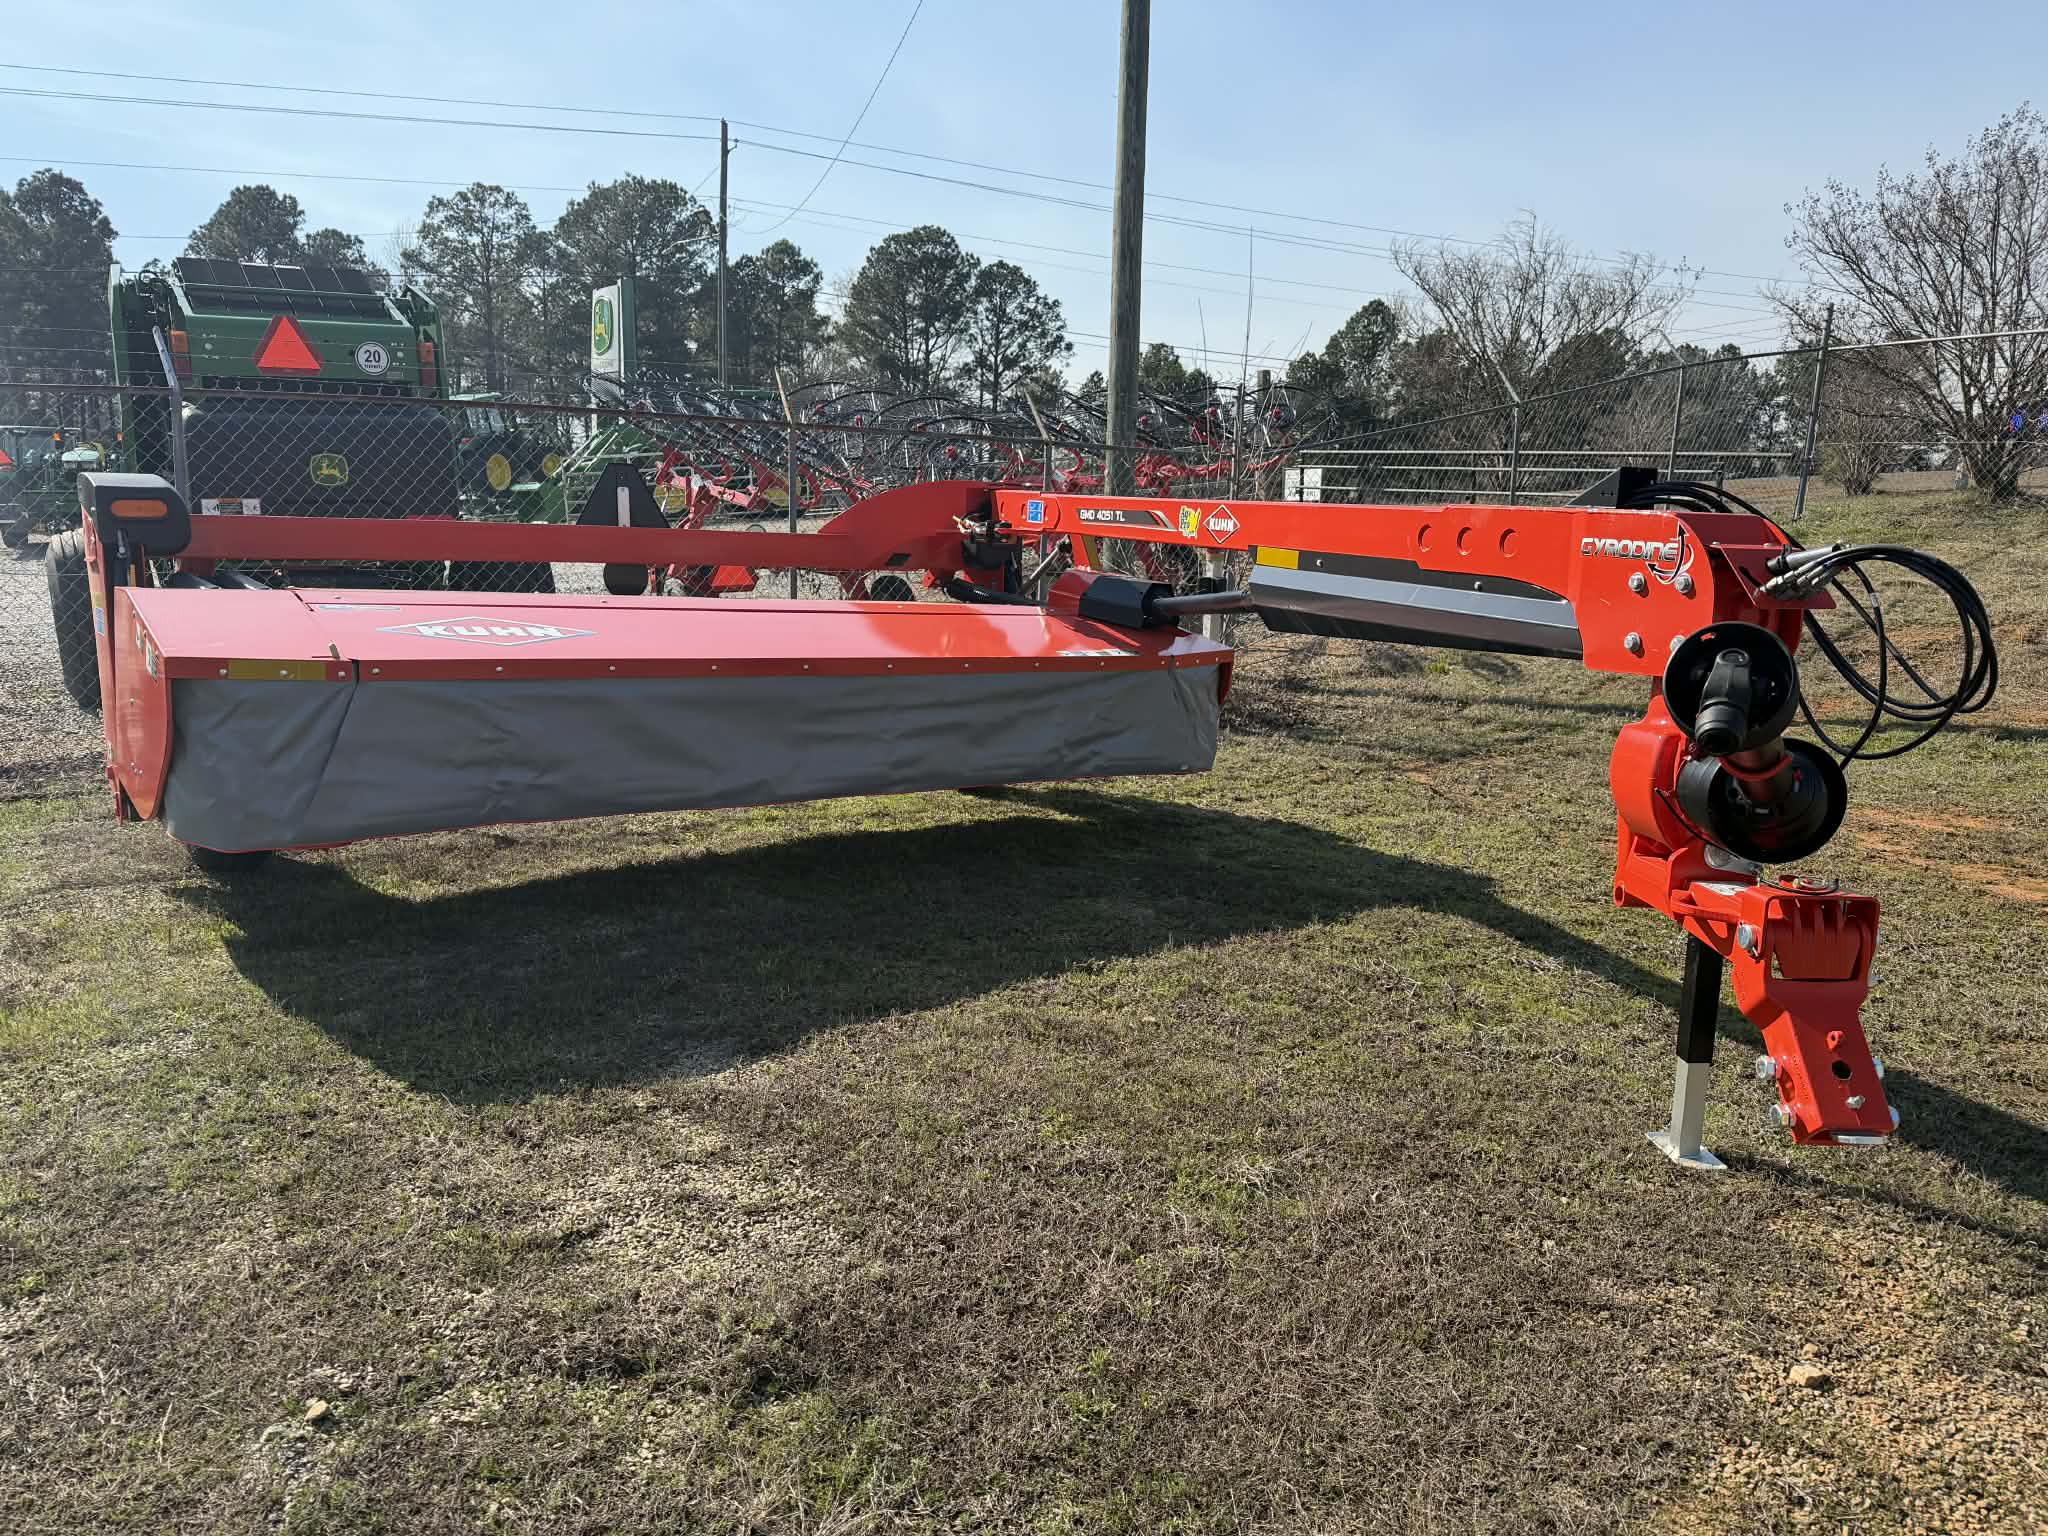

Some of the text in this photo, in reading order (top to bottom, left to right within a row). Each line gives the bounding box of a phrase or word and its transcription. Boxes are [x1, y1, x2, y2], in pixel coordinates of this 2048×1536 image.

[364, 349, 381, 363] 20
[1080, 509, 1126, 521] GMD 4051 TL
[1209, 517, 1234, 532] KUHN
[1581, 537, 1679, 562] GYRODINE
[415, 624, 567, 637] KUHN
